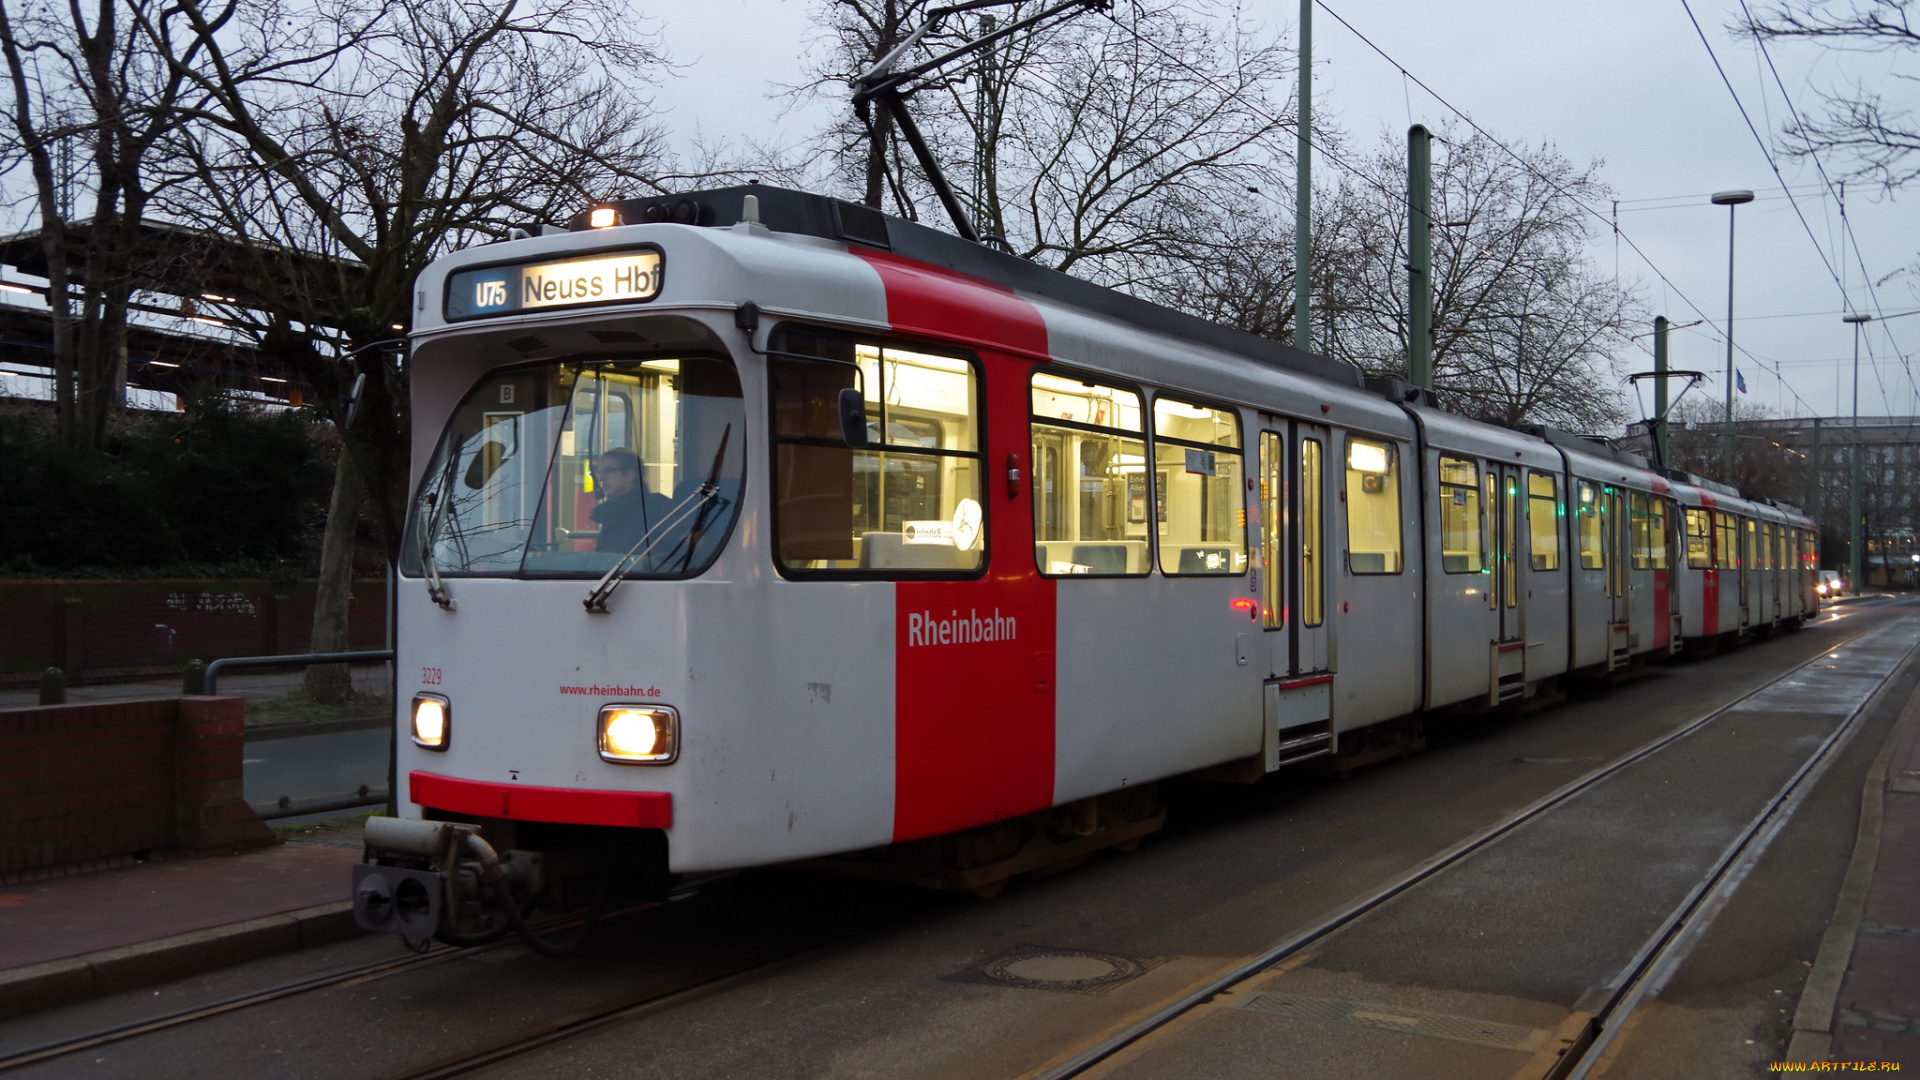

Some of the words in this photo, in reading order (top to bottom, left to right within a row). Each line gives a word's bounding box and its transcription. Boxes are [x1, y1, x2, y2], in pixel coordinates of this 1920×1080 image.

[476, 281, 507, 307] U75
[525, 274, 603, 303] Neuss
[614, 263, 660, 294] Hbf
[503, 386, 512, 401] B
[909, 607, 1016, 647] Rheinbahn
[422, 667, 442, 685] 3229
[559, 684, 661, 697] www.rheinbahn.de
